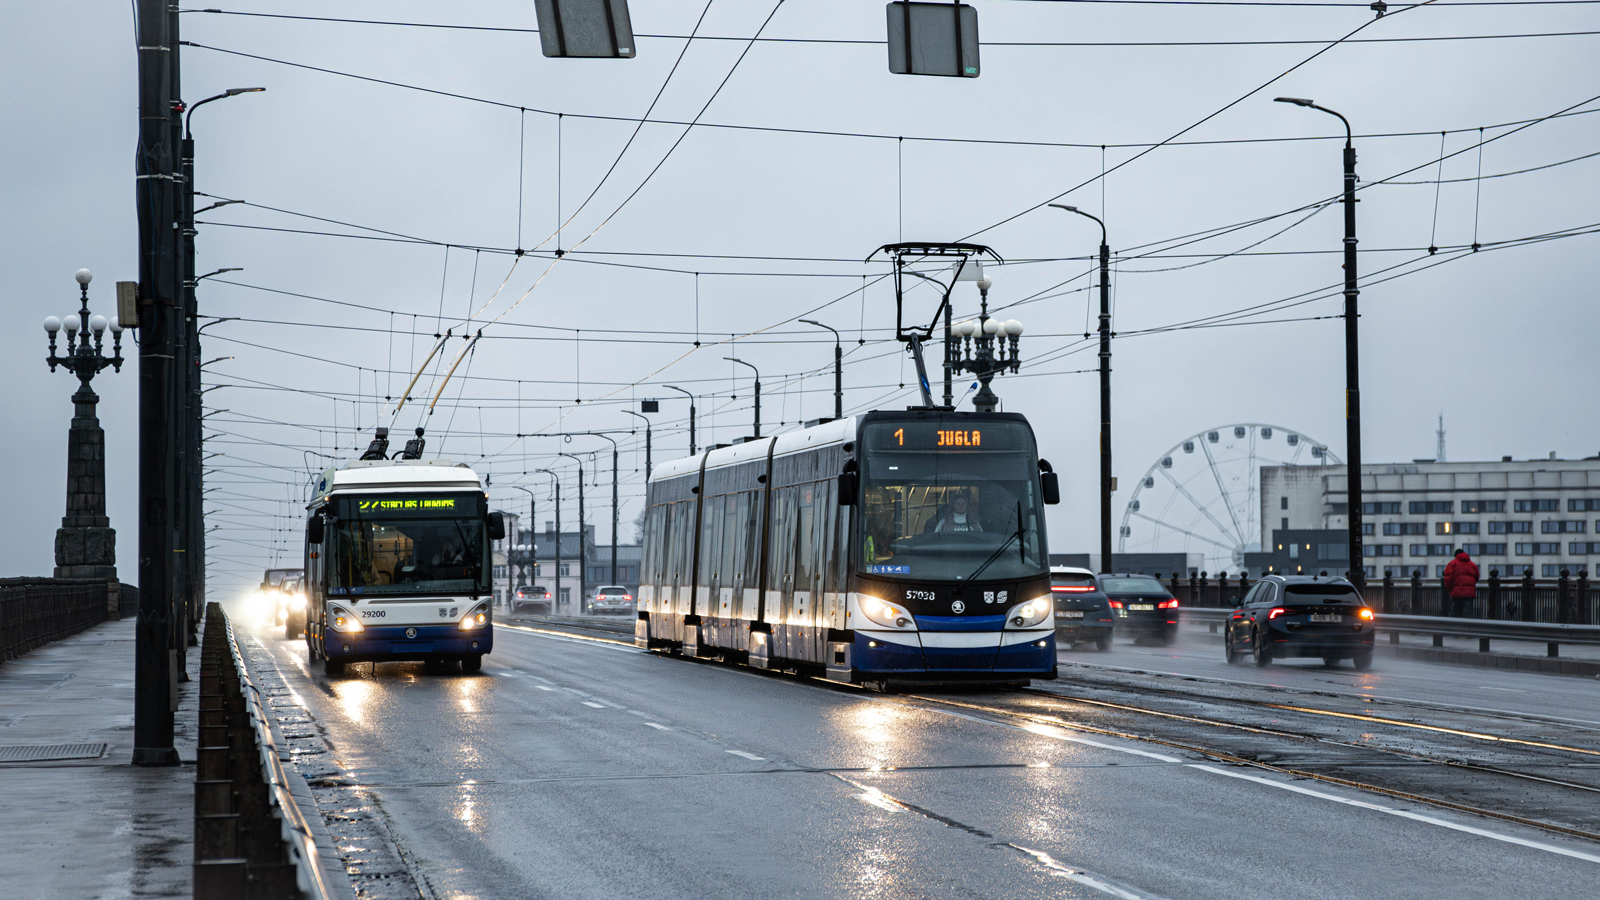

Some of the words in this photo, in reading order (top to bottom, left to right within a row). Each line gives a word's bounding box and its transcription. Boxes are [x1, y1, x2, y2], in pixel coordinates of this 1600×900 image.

[894, 428, 904, 446] 1
[937, 430, 981, 446] JUGLA
[905, 590, 936, 601] 57038
